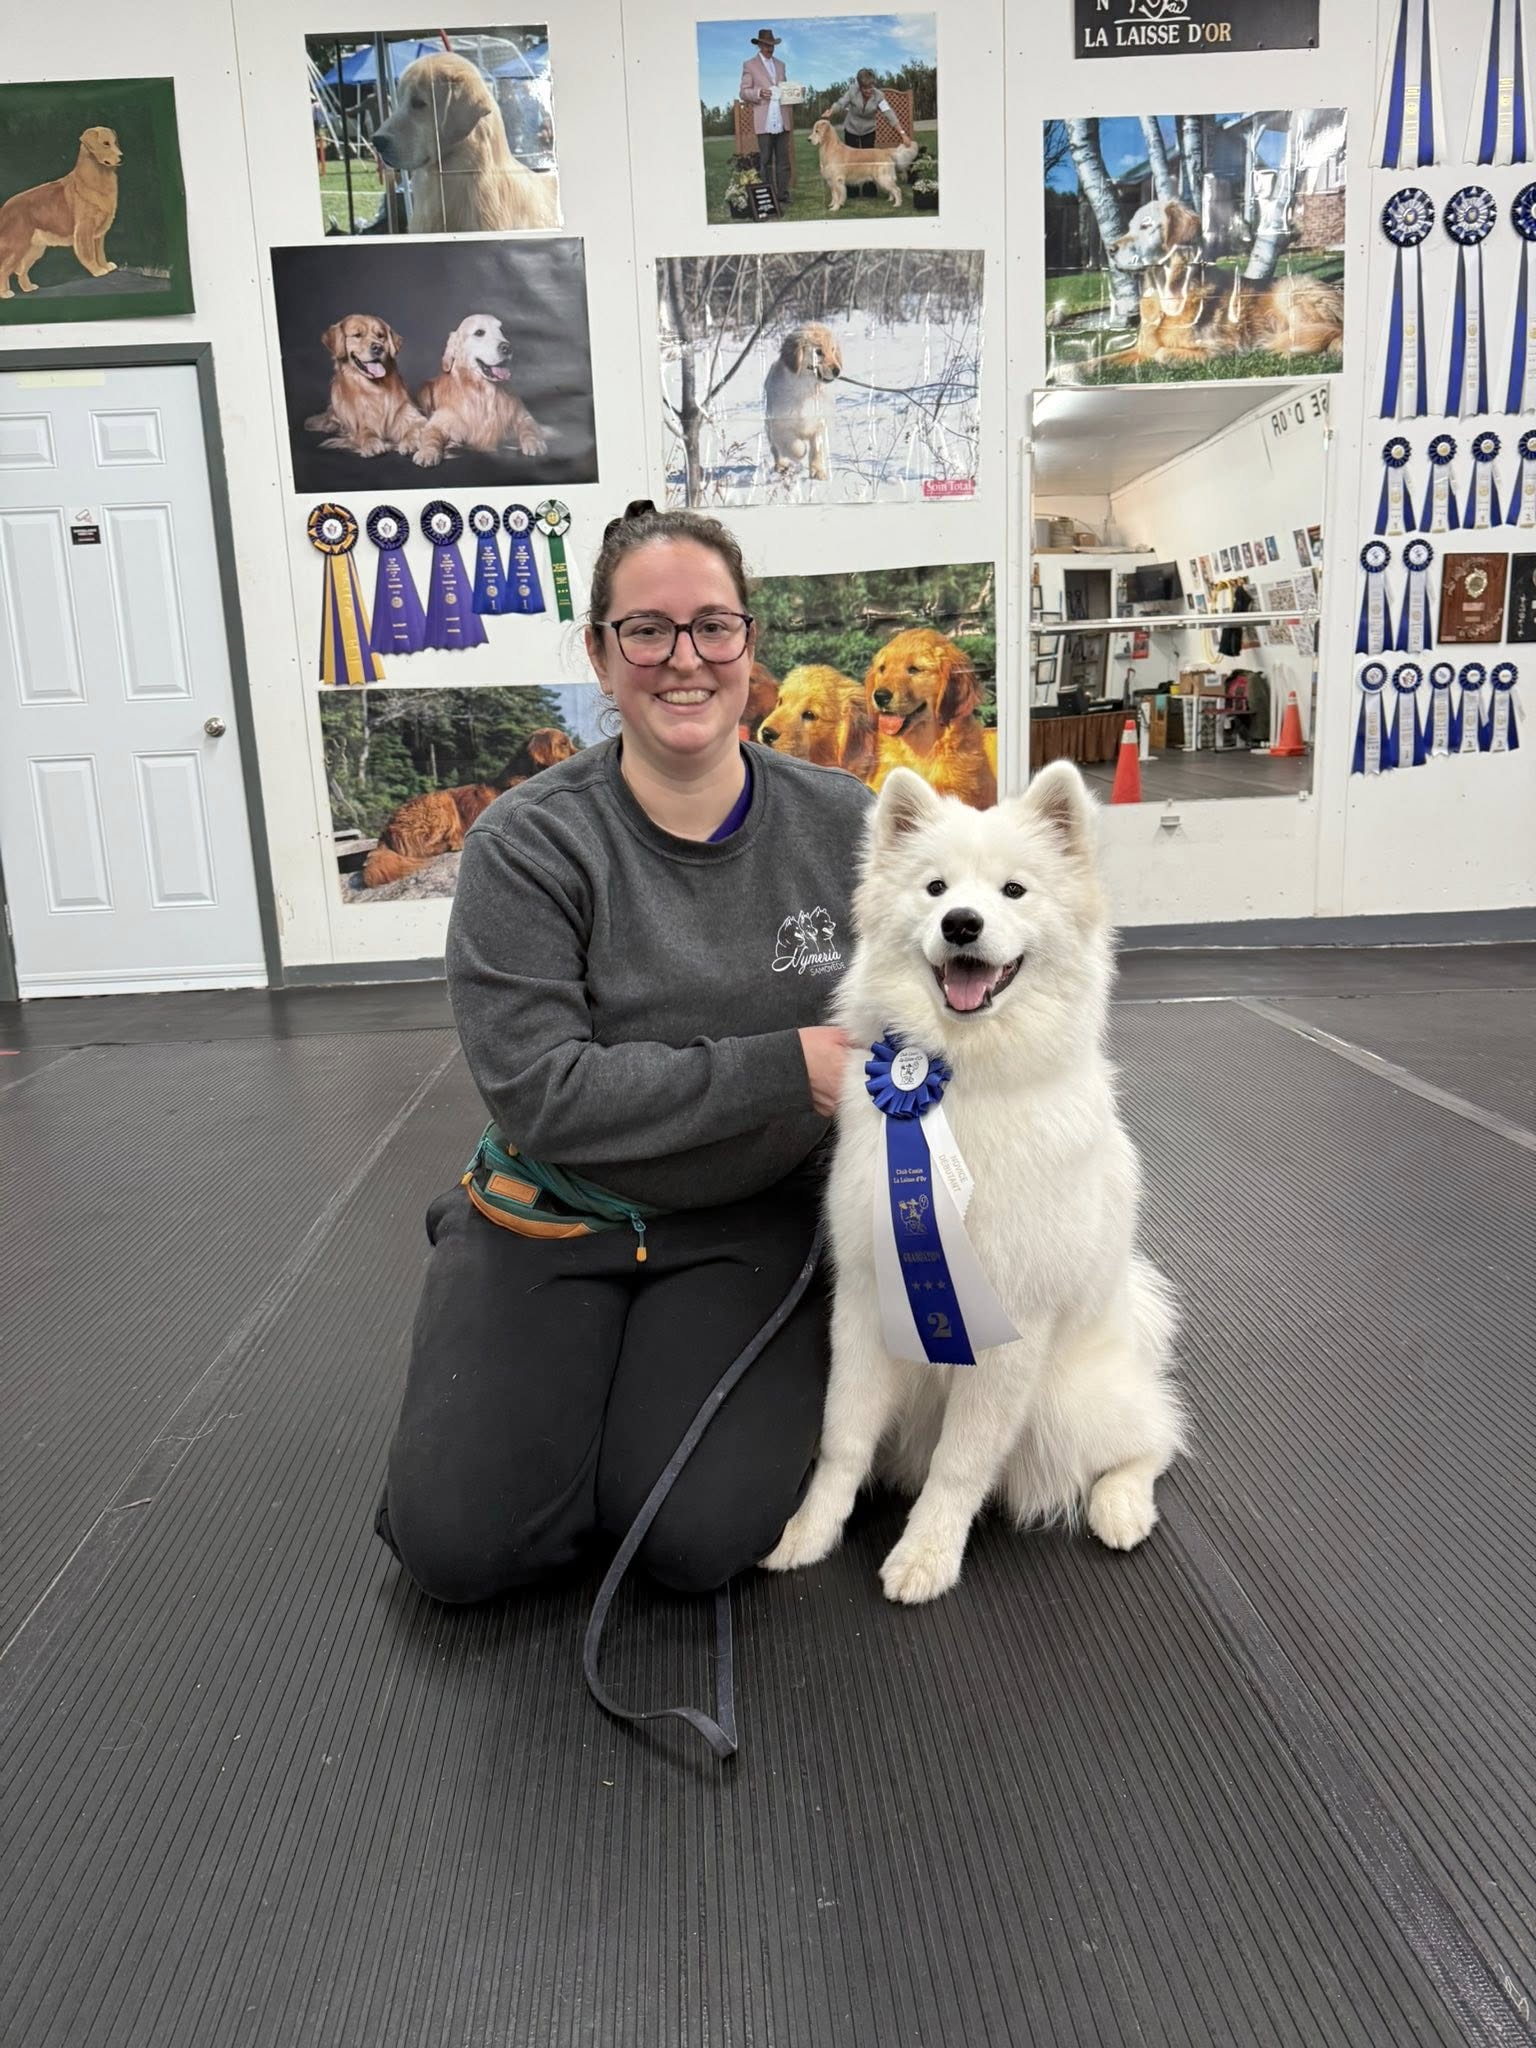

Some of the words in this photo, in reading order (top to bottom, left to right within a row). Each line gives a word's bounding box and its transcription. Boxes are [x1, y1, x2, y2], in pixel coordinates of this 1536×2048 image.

[1084, 27, 1109, 47] LA
[1116, 25, 1180, 46] LAISSE
[1188, 22, 1232, 43] D'OR
[772, 945, 841, 975] Nymeria
[927, 1312, 953, 1338] 2
